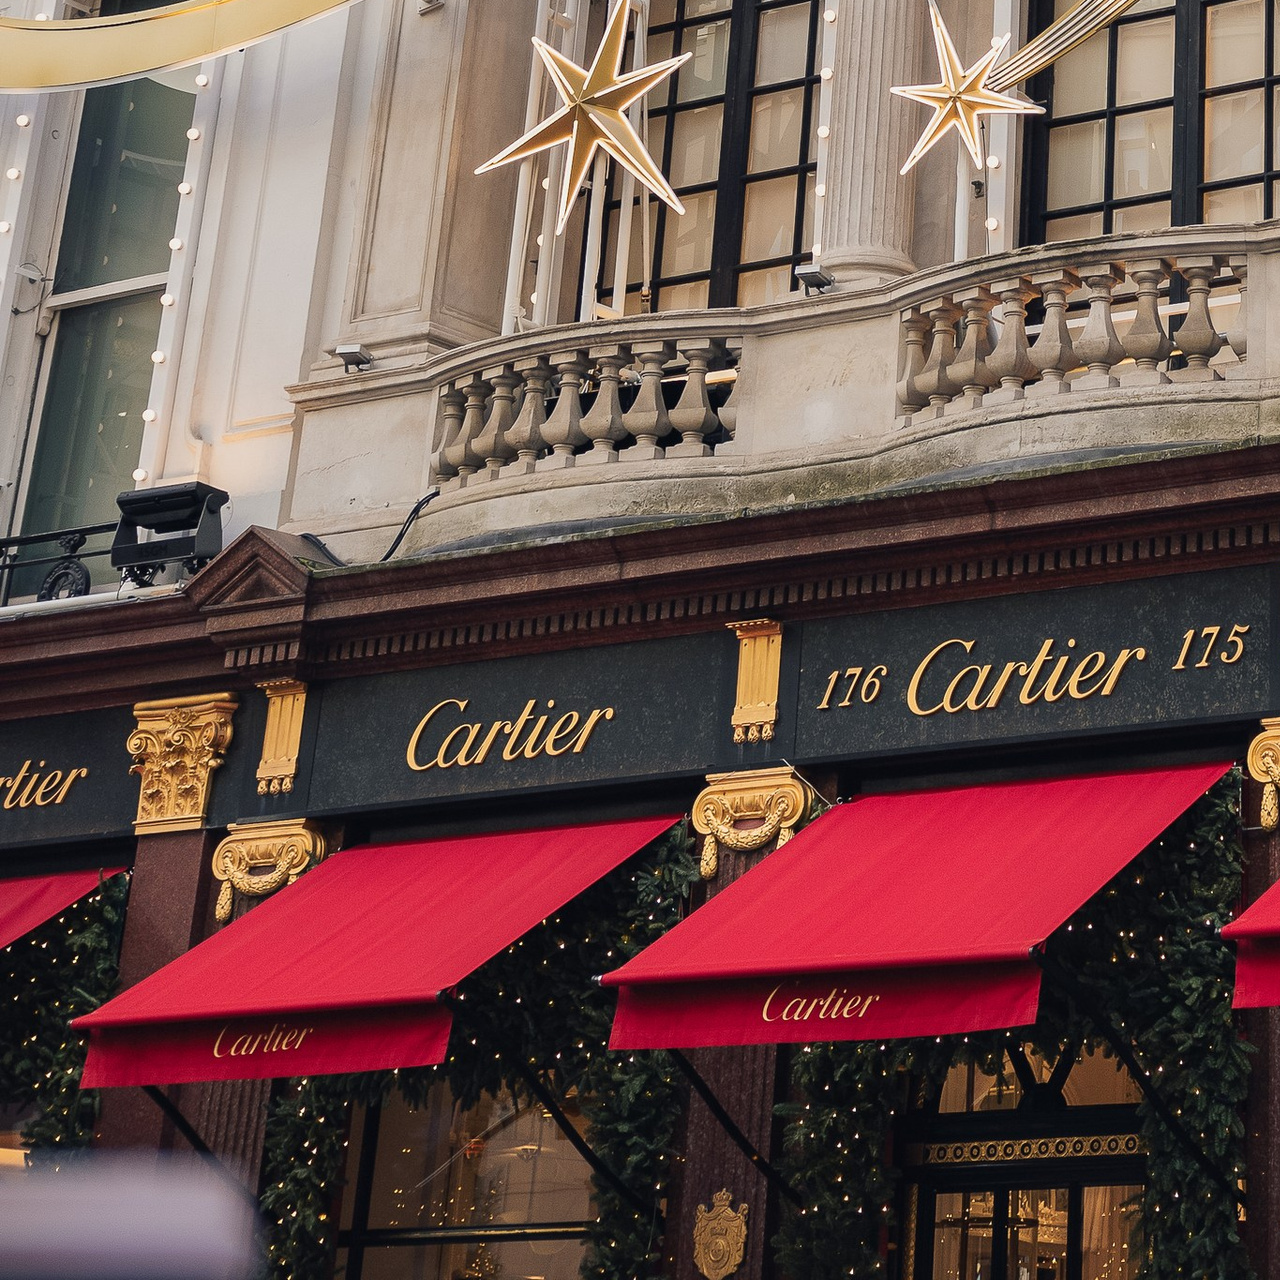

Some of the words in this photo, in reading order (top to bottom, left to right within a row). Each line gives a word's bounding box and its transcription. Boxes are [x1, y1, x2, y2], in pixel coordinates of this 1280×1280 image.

[816, 664, 887, 710] 176
[906, 638, 1146, 716] Cartier
[1172, 624, 1250, 670] 175
[406, 698, 614, 771] Cartier
[762, 980, 880, 1022] Cartier
